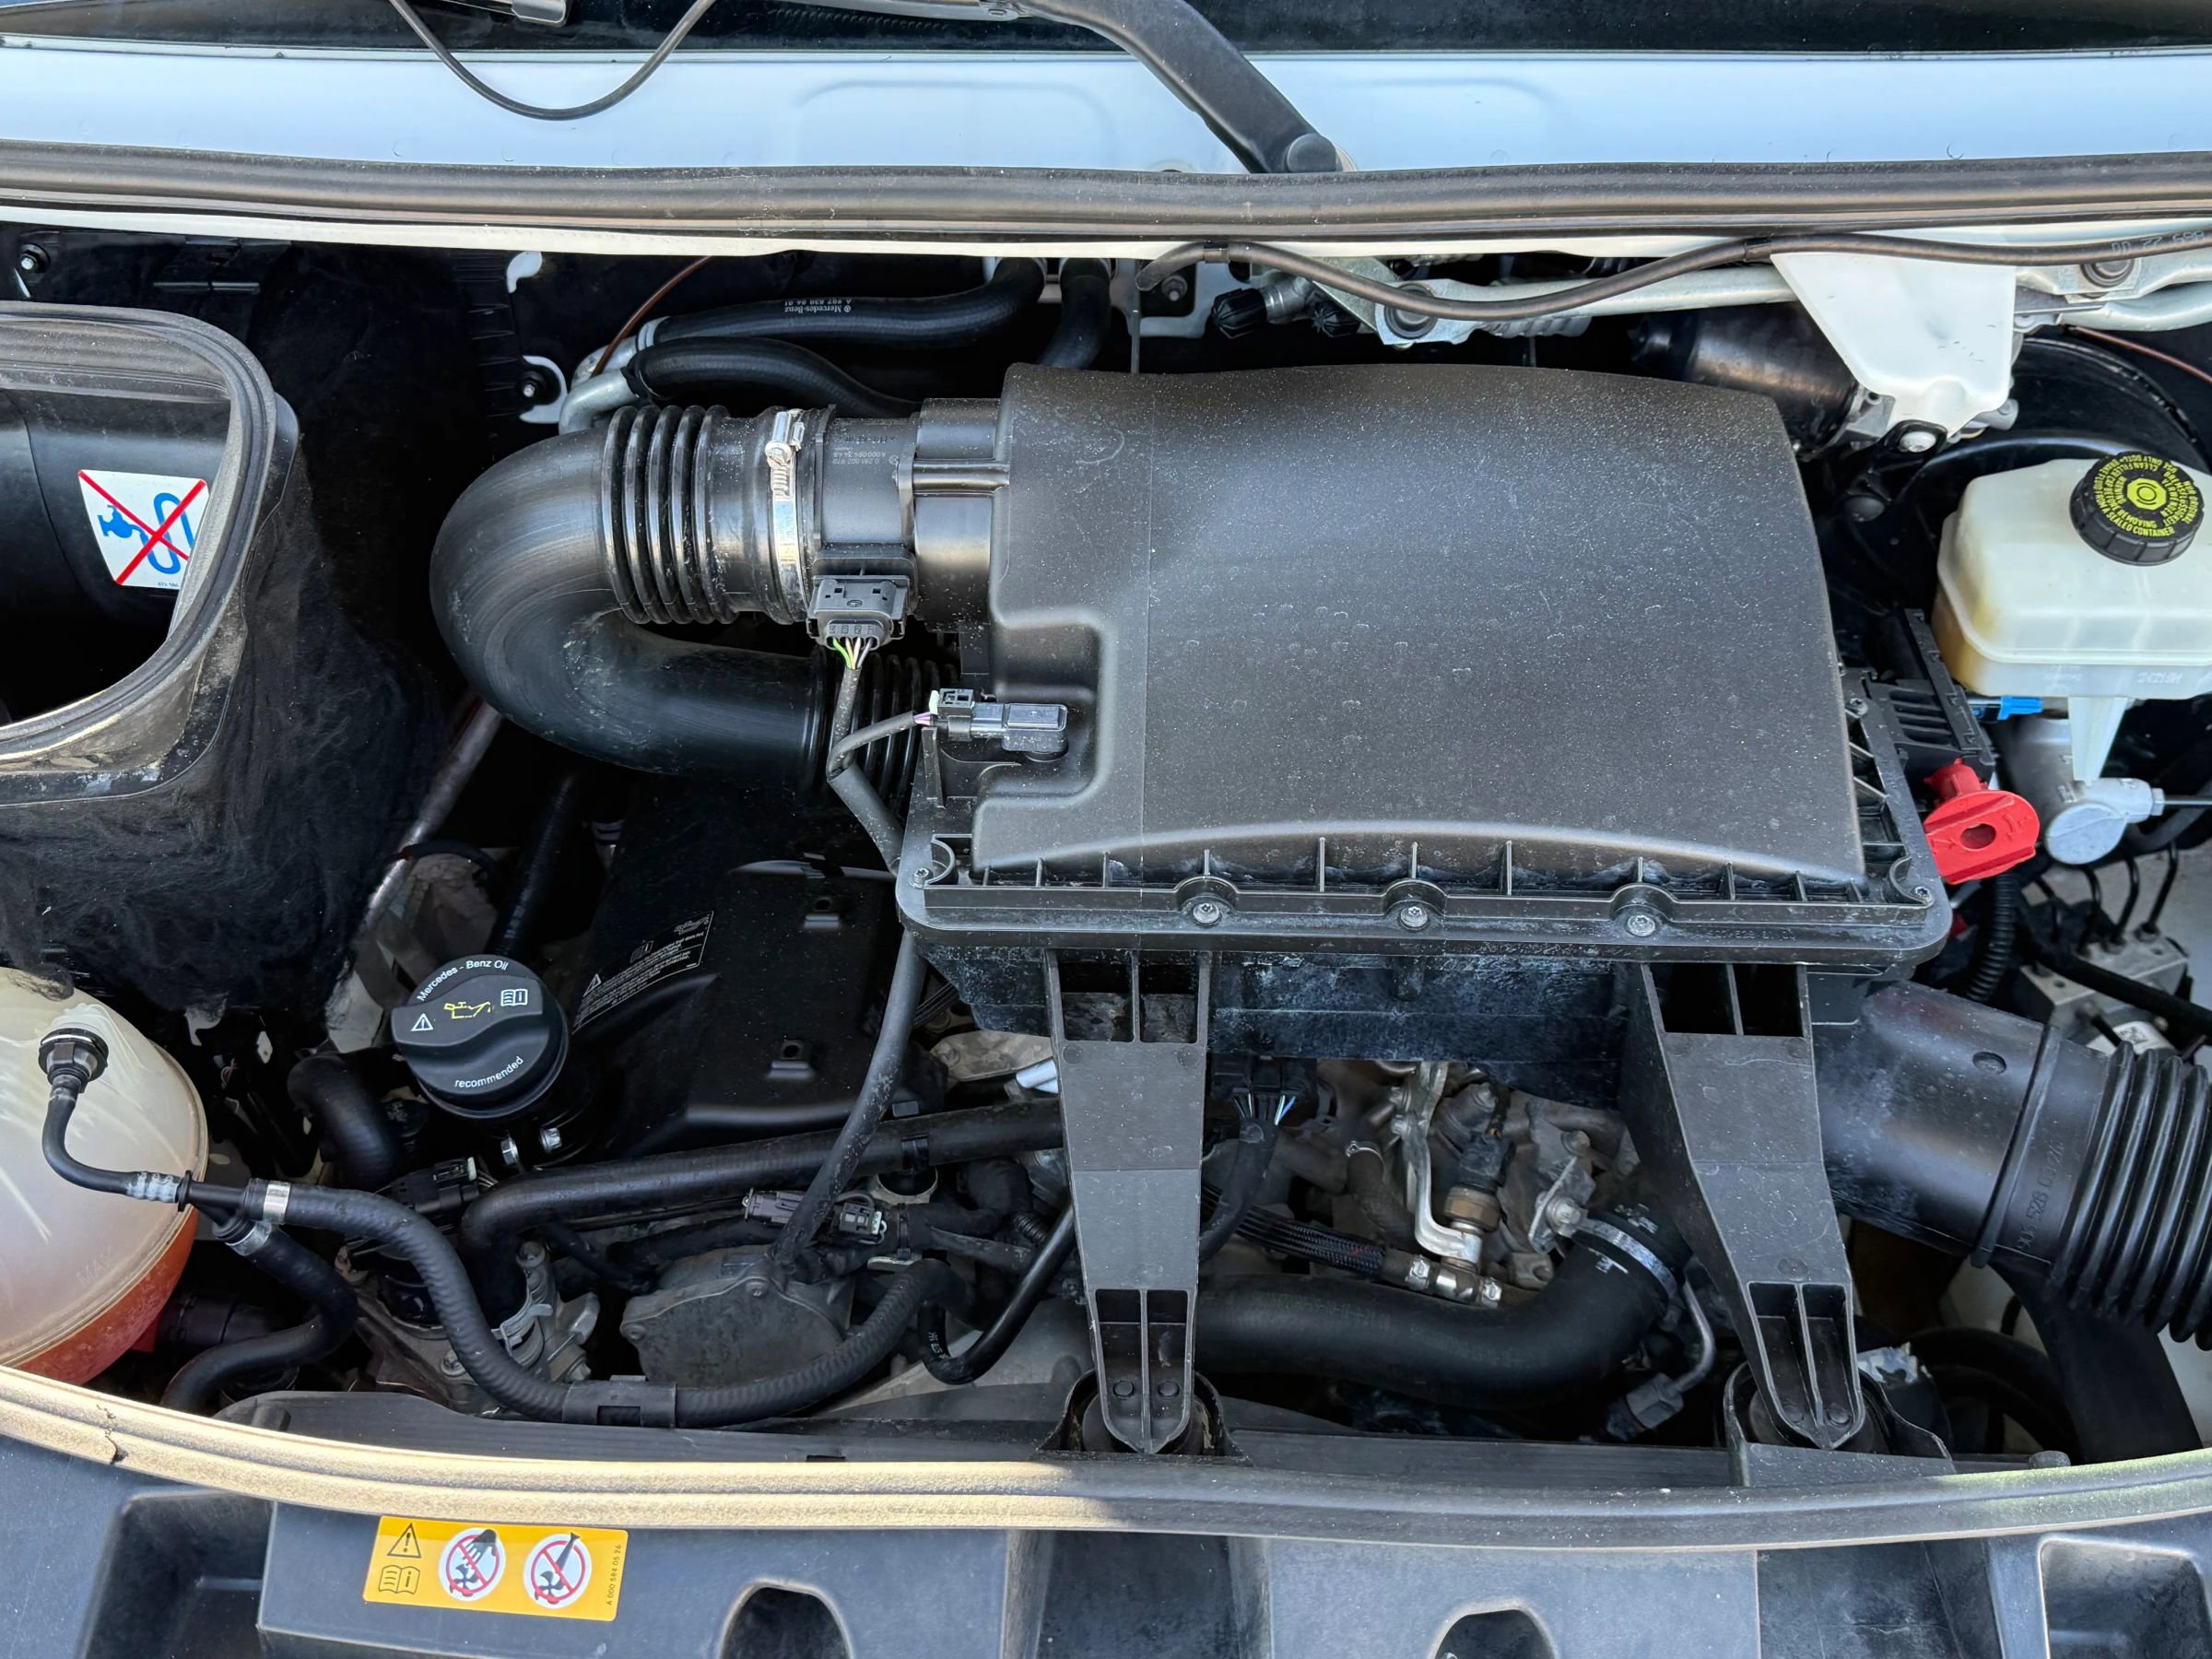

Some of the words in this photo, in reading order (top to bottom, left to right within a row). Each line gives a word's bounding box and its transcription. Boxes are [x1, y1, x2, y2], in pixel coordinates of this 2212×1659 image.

[784, 305, 842, 313] Mercedes-Benz
[2134, 463, 2159, 472] CLEAN
[2143, 456, 2162, 465] ONLY
[2094, 491, 2109, 511] FROM
[2103, 487, 2121, 511] BEFORE
[2106, 512, 2134, 532] SEALED
[2117, 510, 2158, 528] REMOVING
[2133, 526, 2175, 536] CONTAINER
[416, 965, 459, 1003] Mercedes
[466, 959, 492, 970] Benz
[494, 959, 509, 971] Oil
[454, 1055, 524, 1088] recommended
[614, 1544, 621, 1554] 26
[609, 1568, 618, 1582] 584
[607, 1583, 616, 1598] 000
